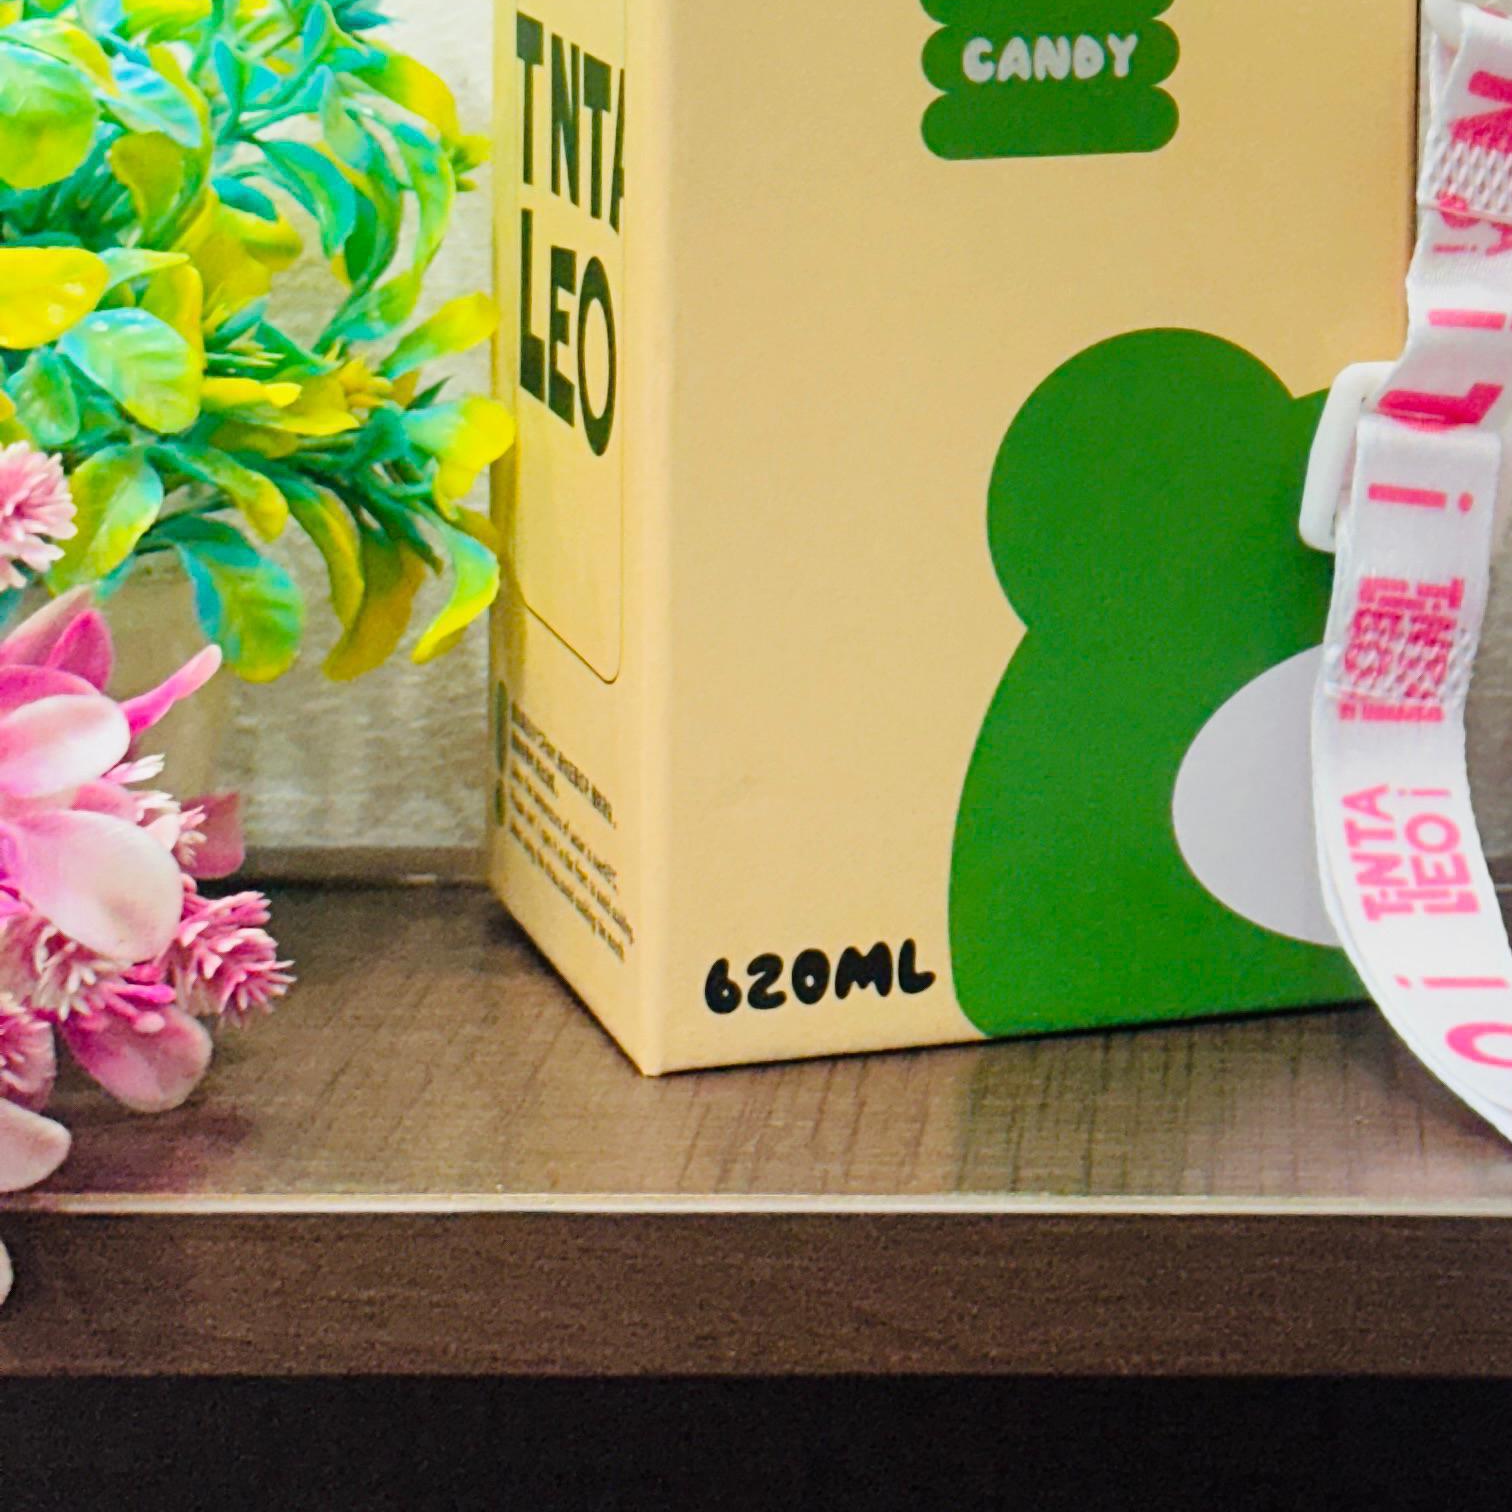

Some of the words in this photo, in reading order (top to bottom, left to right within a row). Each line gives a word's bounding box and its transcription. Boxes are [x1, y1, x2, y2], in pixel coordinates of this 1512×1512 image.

[962, 33, 1139, 83] CANDY
[518, 207, 618, 456] LEO
[704, 937, 937, 1015] 620ML
